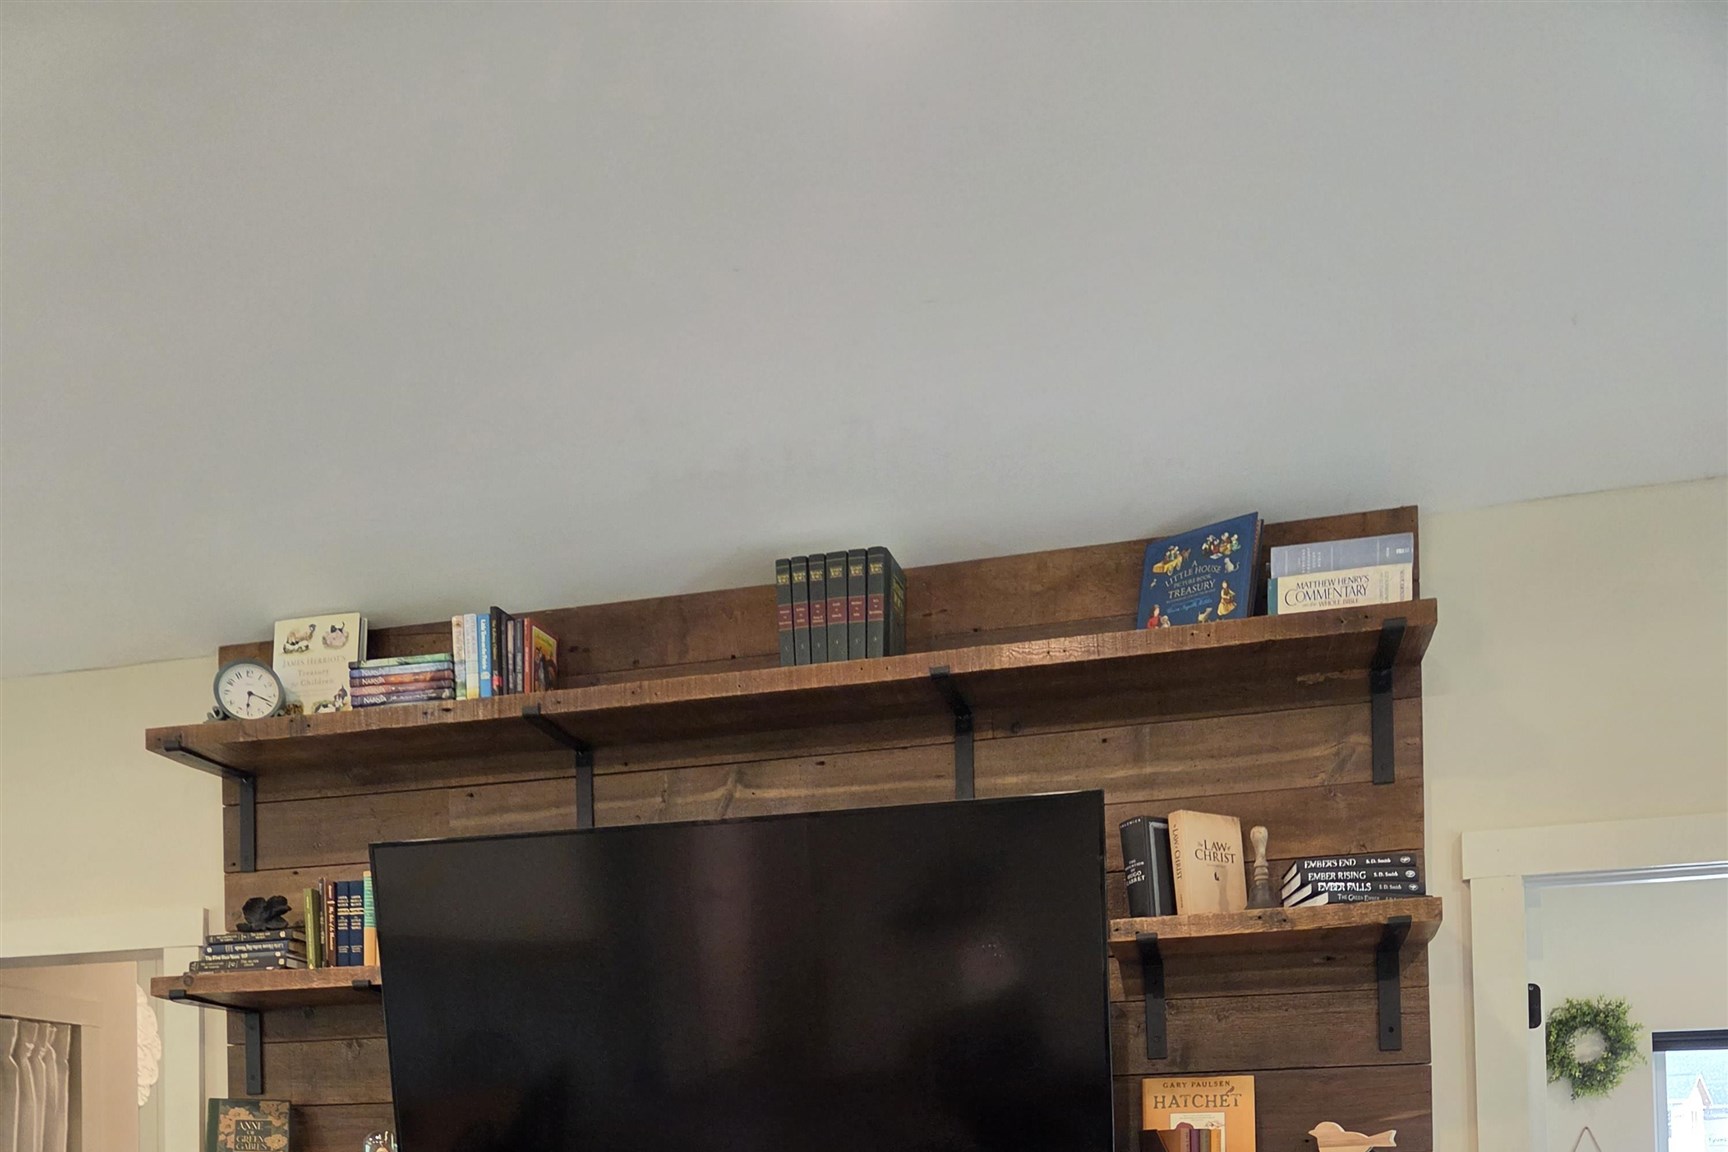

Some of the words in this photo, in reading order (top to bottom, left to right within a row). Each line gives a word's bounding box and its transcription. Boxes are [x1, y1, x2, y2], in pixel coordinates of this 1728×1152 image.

[1165, 569, 1193, 587] LITTLE
[1195, 565, 1221, 574] HOUSE
[1296, 579, 1335, 590] MATTHEW
[1337, 575, 1370, 587] HENRY'S
[1168, 579, 1216, 599] TREASURY
[1284, 583, 1368, 606] COMMENTARY
[1204, 839, 1228, 852] LAW
[1194, 848, 1237, 864] CHRIST
[1339, 858, 1357, 866] END
[1308, 871, 1336, 881] EMBER
[1338, 871, 1367, 880] RISING
[1318, 882, 1345, 892] EMBER
[1346, 882, 1372, 892] FALLS
[1191, 1080, 1231, 1088] PAULSEN
[1153, 1093, 1242, 1109] HATCHET
[238, 1121, 264, 1130] ANNE
[236, 1142, 268, 1150] GABLES
